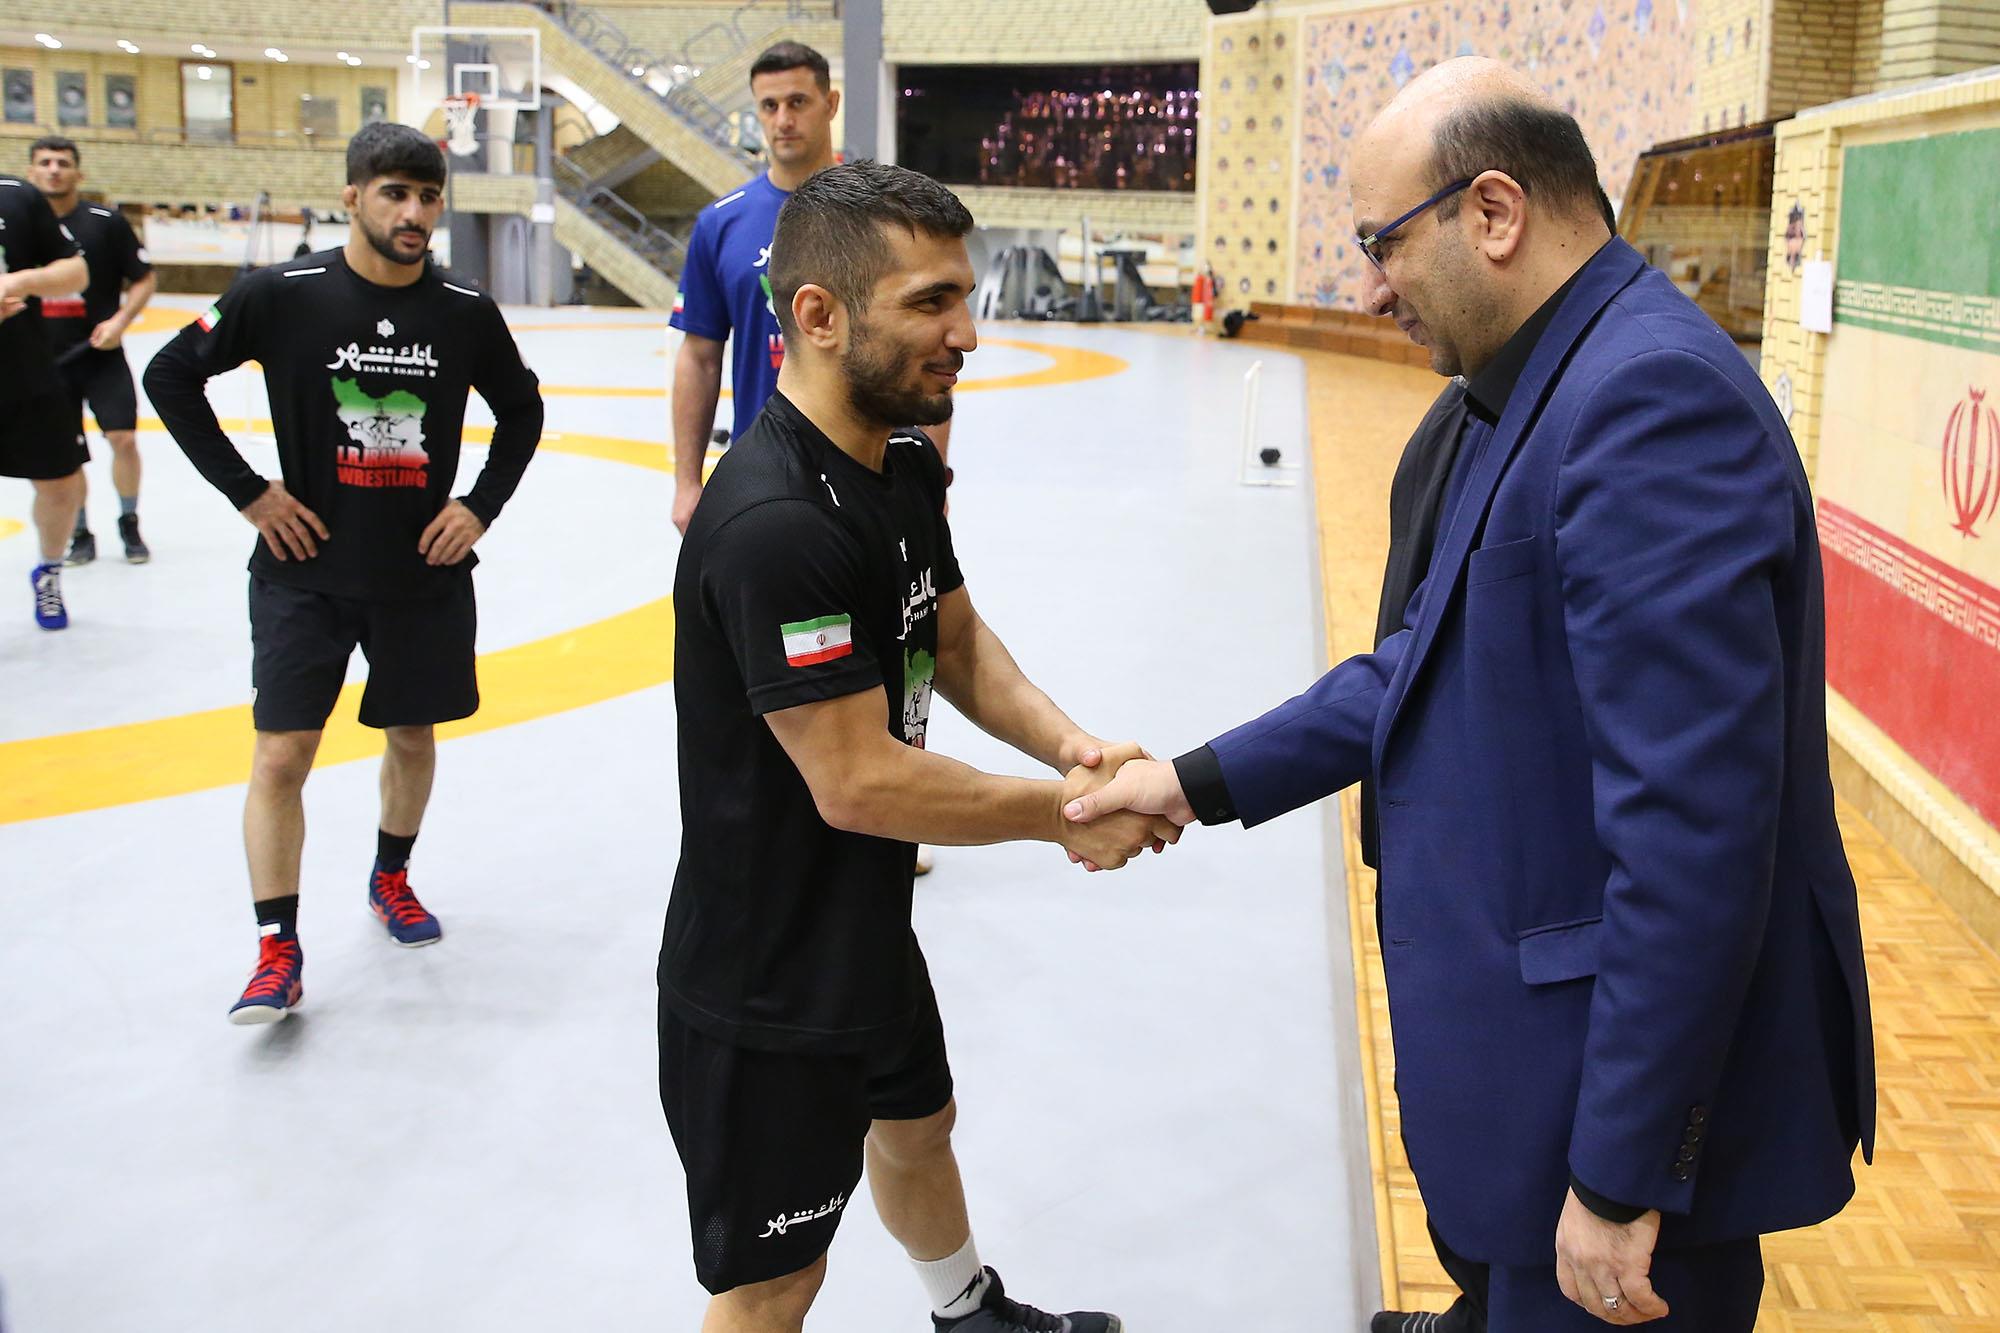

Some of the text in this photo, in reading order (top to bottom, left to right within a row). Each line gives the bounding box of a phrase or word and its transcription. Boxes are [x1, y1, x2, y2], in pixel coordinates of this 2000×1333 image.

[325, 342, 394, 372] شهر
[363, 364, 390, 374] BANK
[336, 466, 428, 488] WRESTLING
[758, 1208, 814, 1238] شهر
